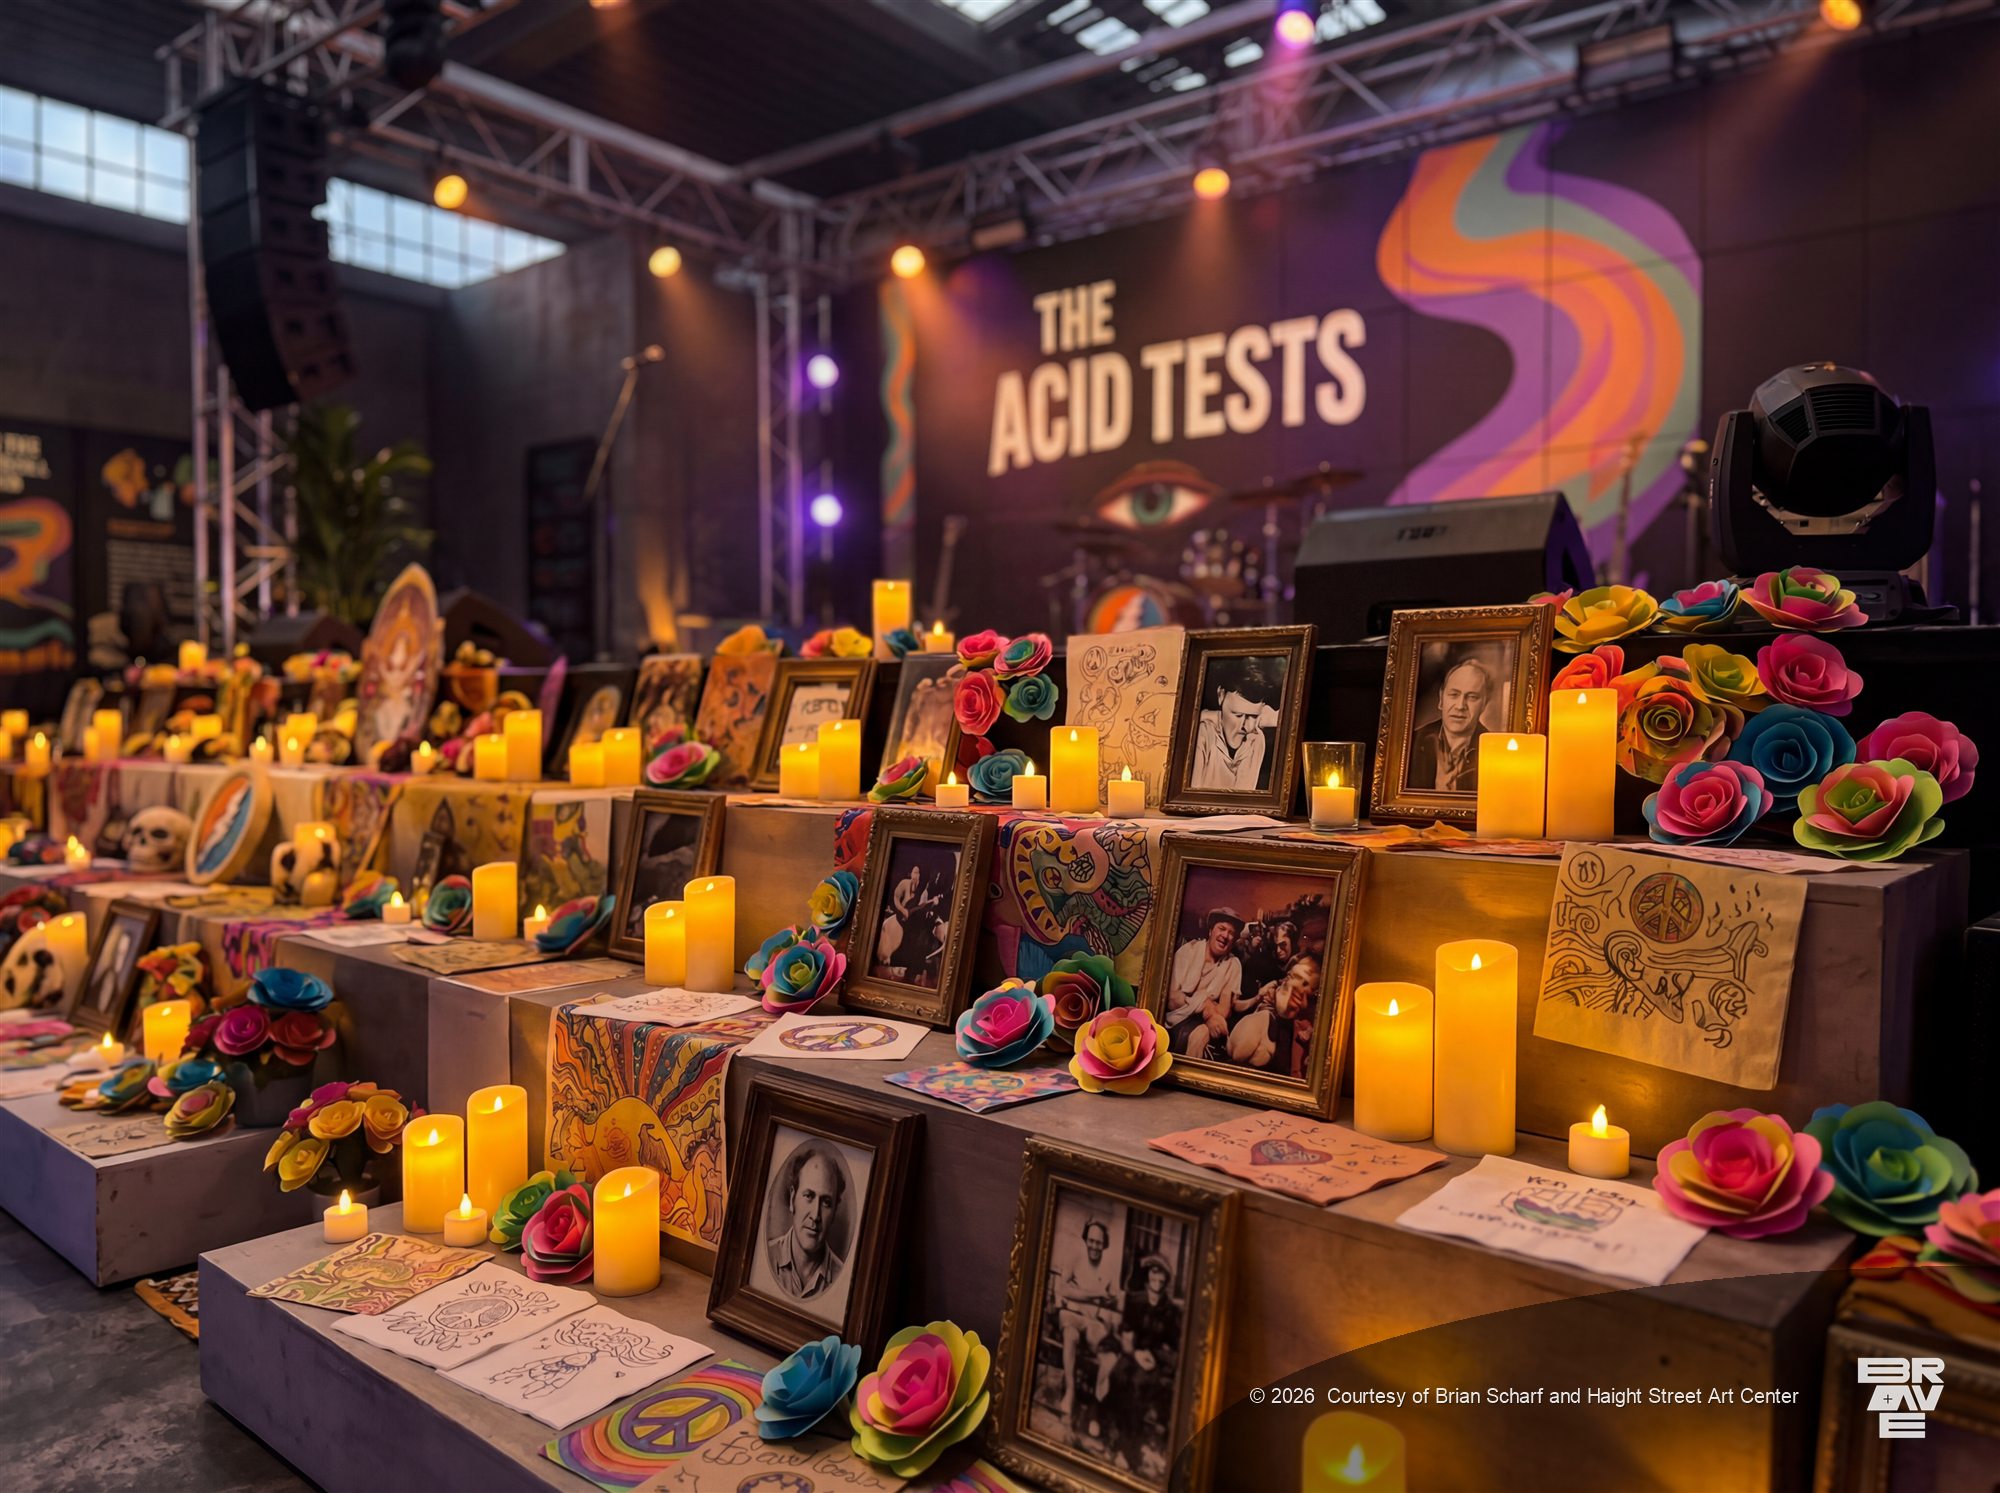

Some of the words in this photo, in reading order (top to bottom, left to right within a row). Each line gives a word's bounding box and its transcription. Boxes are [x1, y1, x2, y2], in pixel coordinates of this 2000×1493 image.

[1034, 280, 1116, 354] THE
[988, 350, 1133, 477] ACID
[1140, 309, 1367, 444] TESTS
